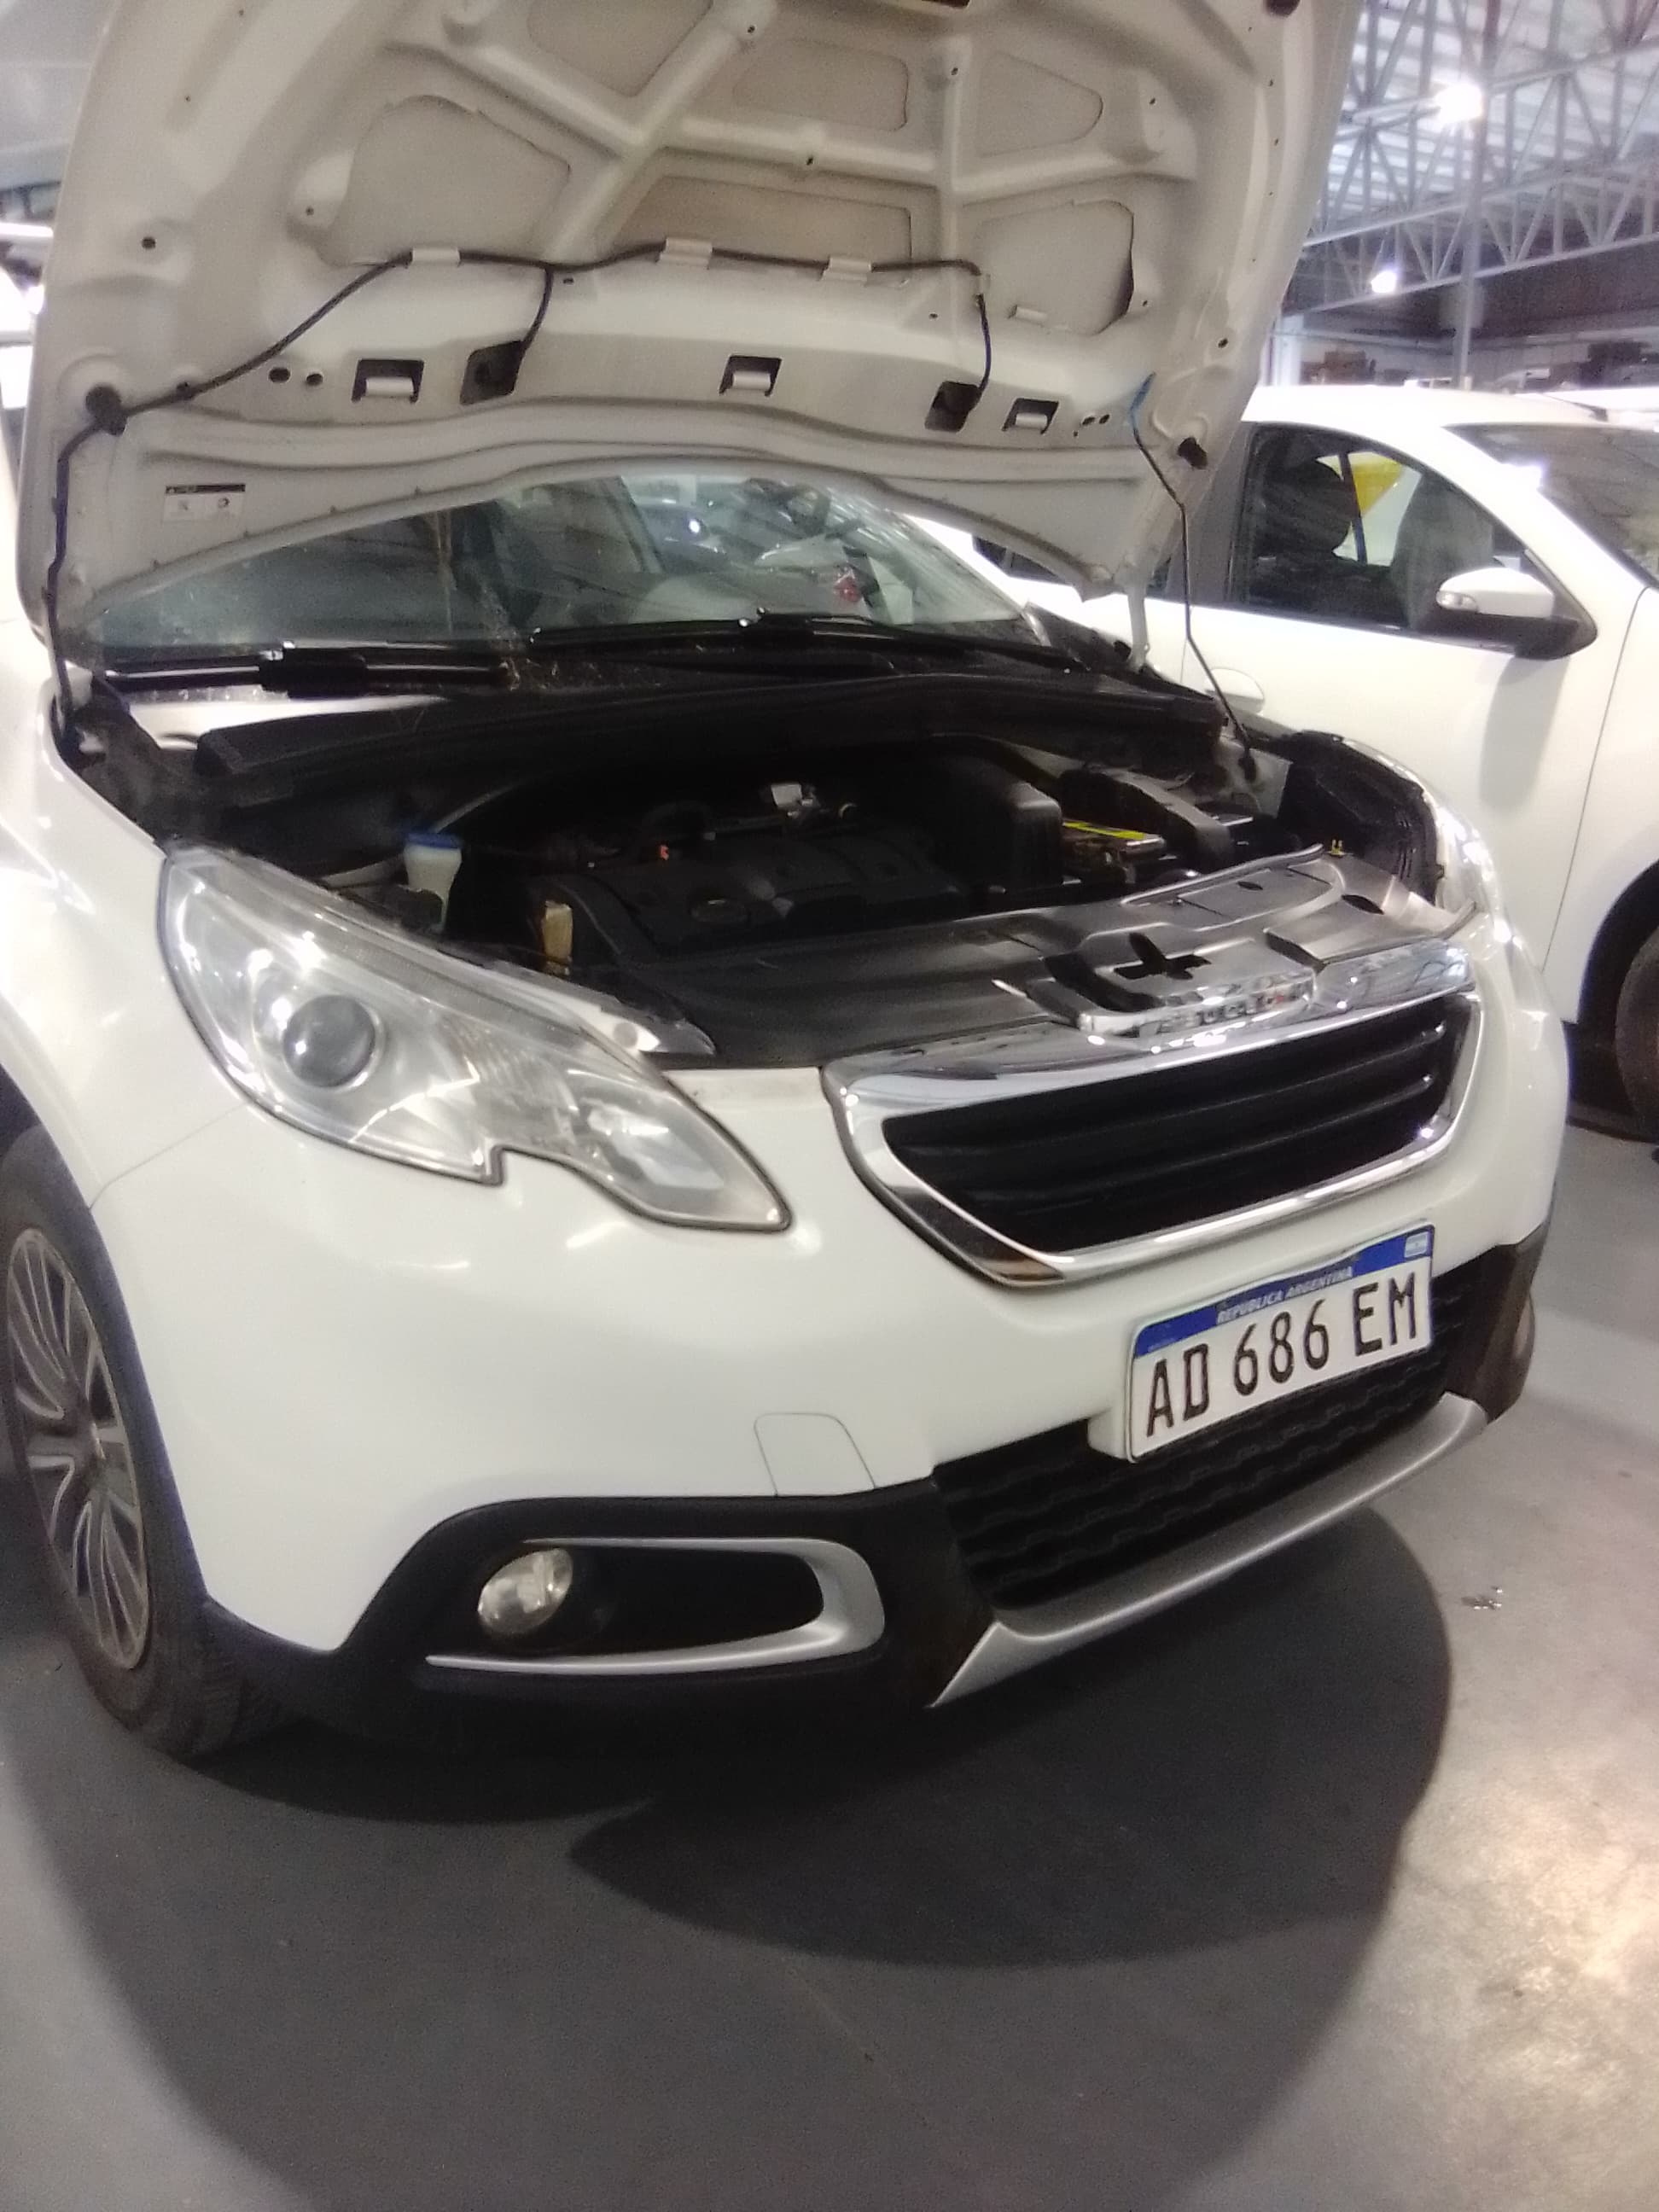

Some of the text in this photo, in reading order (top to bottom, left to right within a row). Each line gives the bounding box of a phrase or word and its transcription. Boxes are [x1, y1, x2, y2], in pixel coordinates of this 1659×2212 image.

[1284, 1266, 1353, 1299] ARGENTINA
[1146, 1272, 1417, 1437] AD 686 EM
